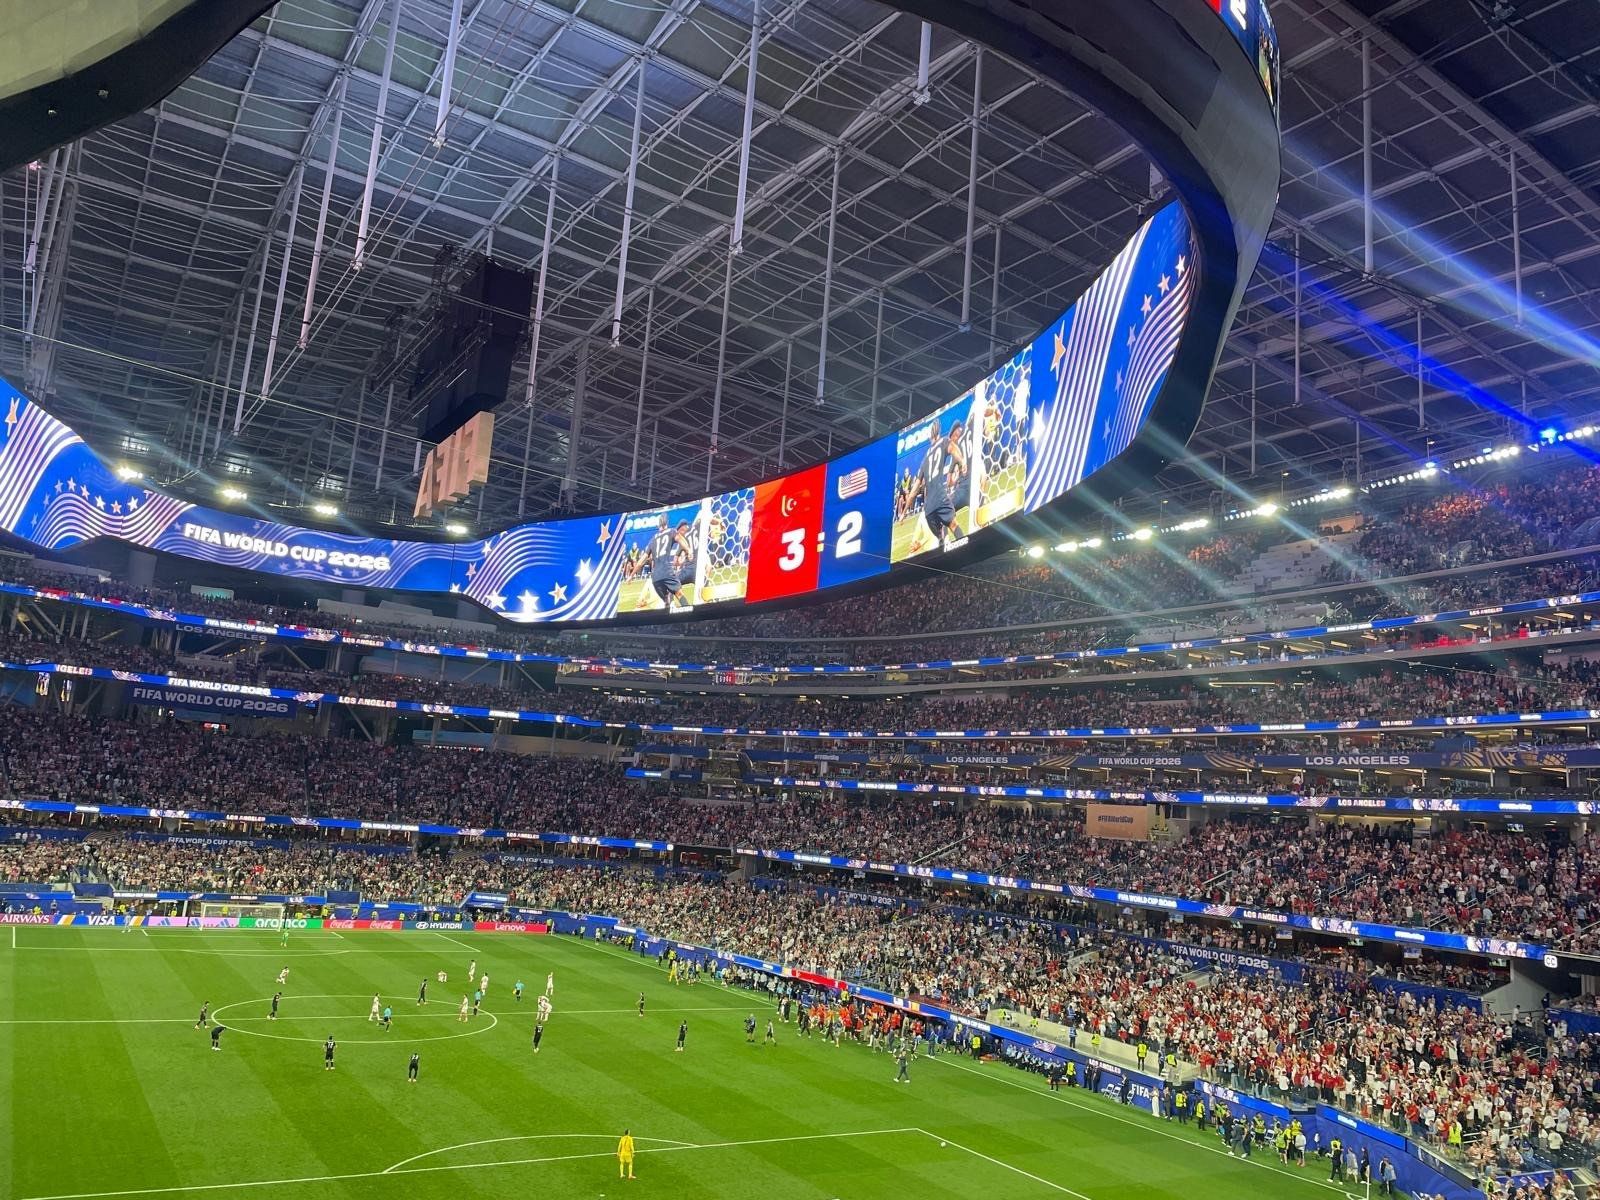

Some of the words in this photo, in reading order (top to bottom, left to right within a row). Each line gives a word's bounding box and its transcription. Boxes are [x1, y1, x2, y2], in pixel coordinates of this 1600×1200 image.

[928, 446, 942, 481] 12
[184, 523, 221, 544] FIFA
[224, 532, 288, 557] WORLD
[290, 545, 327, 563] CUP
[328, 551, 390, 571] 2026
[656, 534, 669, 558] 12
[779, 528, 805, 571] 3
[836, 511, 862, 558] 2
[176, 624, 203, 633] LOS
[206, 628, 267, 641] ANGELES
[168, 678, 189, 687] FIFA
[190, 680, 222, 690] WORLD
[222, 682, 240, 692] CUP
[240, 686, 271, 696] 2026
[133, 688, 163, 701] FIFA
[165, 692, 213, 706] WORLD
[215, 697, 242, 708] CUP
[242, 701, 288, 713] 2026
[338, 696, 357, 704] LOS
[358, 697, 397, 708] ANGELES
[966, 756, 1008, 764] ANGELES
[1098, 757, 1118, 765] FIFA
[1119, 757, 1139, 765] WORLD
[1155, 758, 1182, 766] 2026
[1305, 756, 1334, 765] LOS
[1337, 756, 1410, 765] ANGELES
[1353, 799, 1386, 807] ANGELES
[1098, 815, 1134, 824] #FIFAWorldCup
[1, 914, 50, 924] AIRWAYS
[88, 915, 115, 925] VISA
[1243, 910, 1256, 918] LOS
[1258, 912, 1288, 922] ANGELES
[255, 918, 307, 928] aramco
[430, 921, 462, 929] HYUNDAI
[495, 923, 526, 932] Lenovo
[1172, 945, 1188, 956] FIFA
[1188, 948, 1218, 961] WORLD
[1238, 956, 1270, 970] 2026
[1131, 1083, 1150, 1099] FIFA
